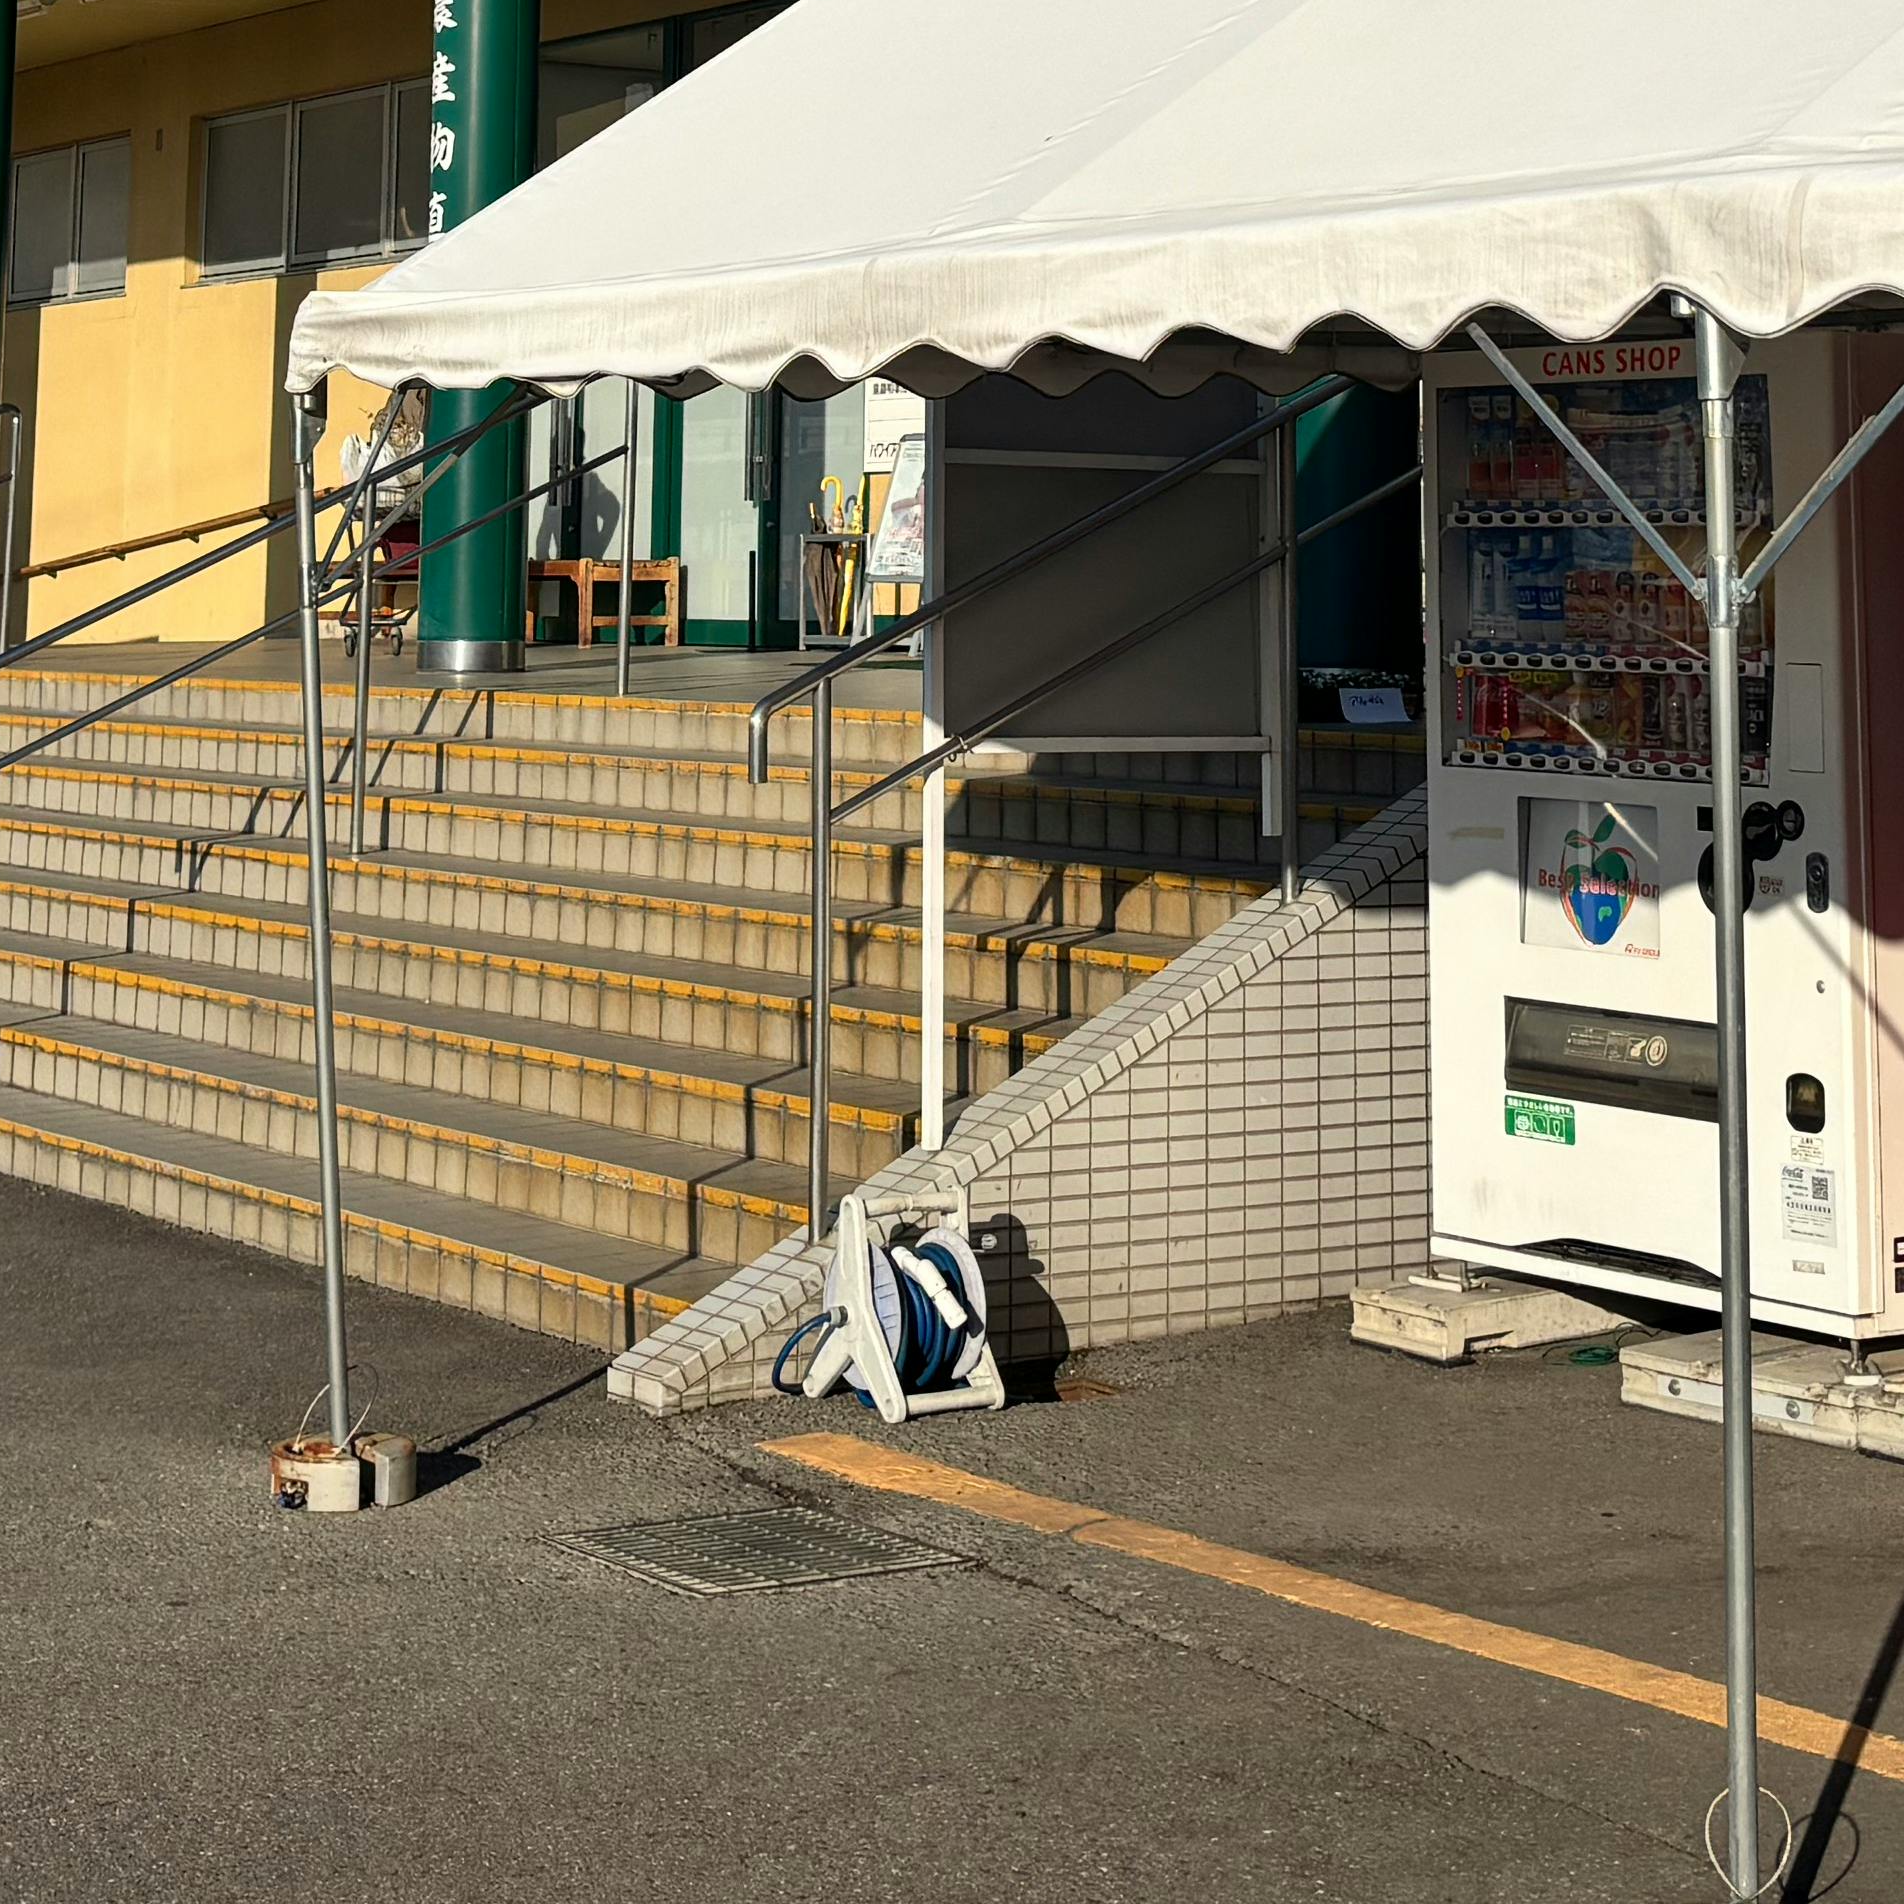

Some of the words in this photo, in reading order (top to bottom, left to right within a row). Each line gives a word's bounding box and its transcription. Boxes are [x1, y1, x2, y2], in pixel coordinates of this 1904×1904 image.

[1542, 349, 1606, 376] CANS
[1616, 346, 1681, 373] SHOP
[1538, 869, 1573, 892] Best
[1578, 873, 1660, 899] Selection
